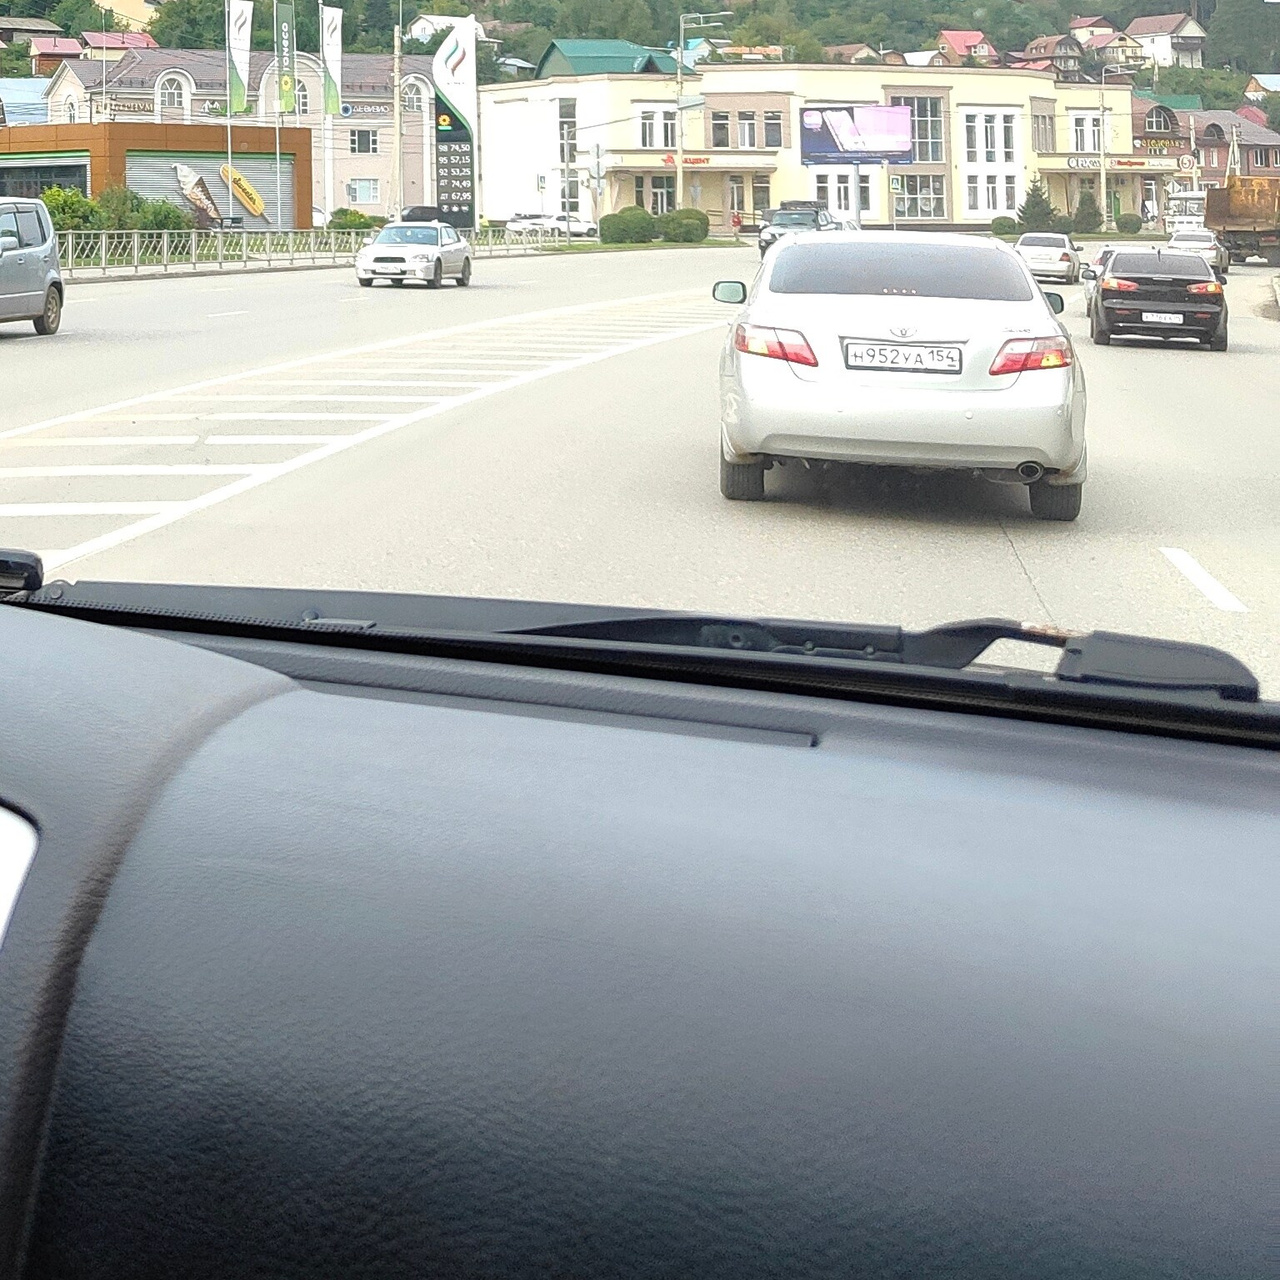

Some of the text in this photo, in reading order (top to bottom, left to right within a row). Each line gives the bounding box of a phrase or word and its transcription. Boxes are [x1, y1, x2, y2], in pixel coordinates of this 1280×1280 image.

[438, 155, 471, 165] 95 57,15
[438, 168, 449, 176] 92
[451, 179, 472, 189] 74,49
[451, 192, 472, 201] 67,95
